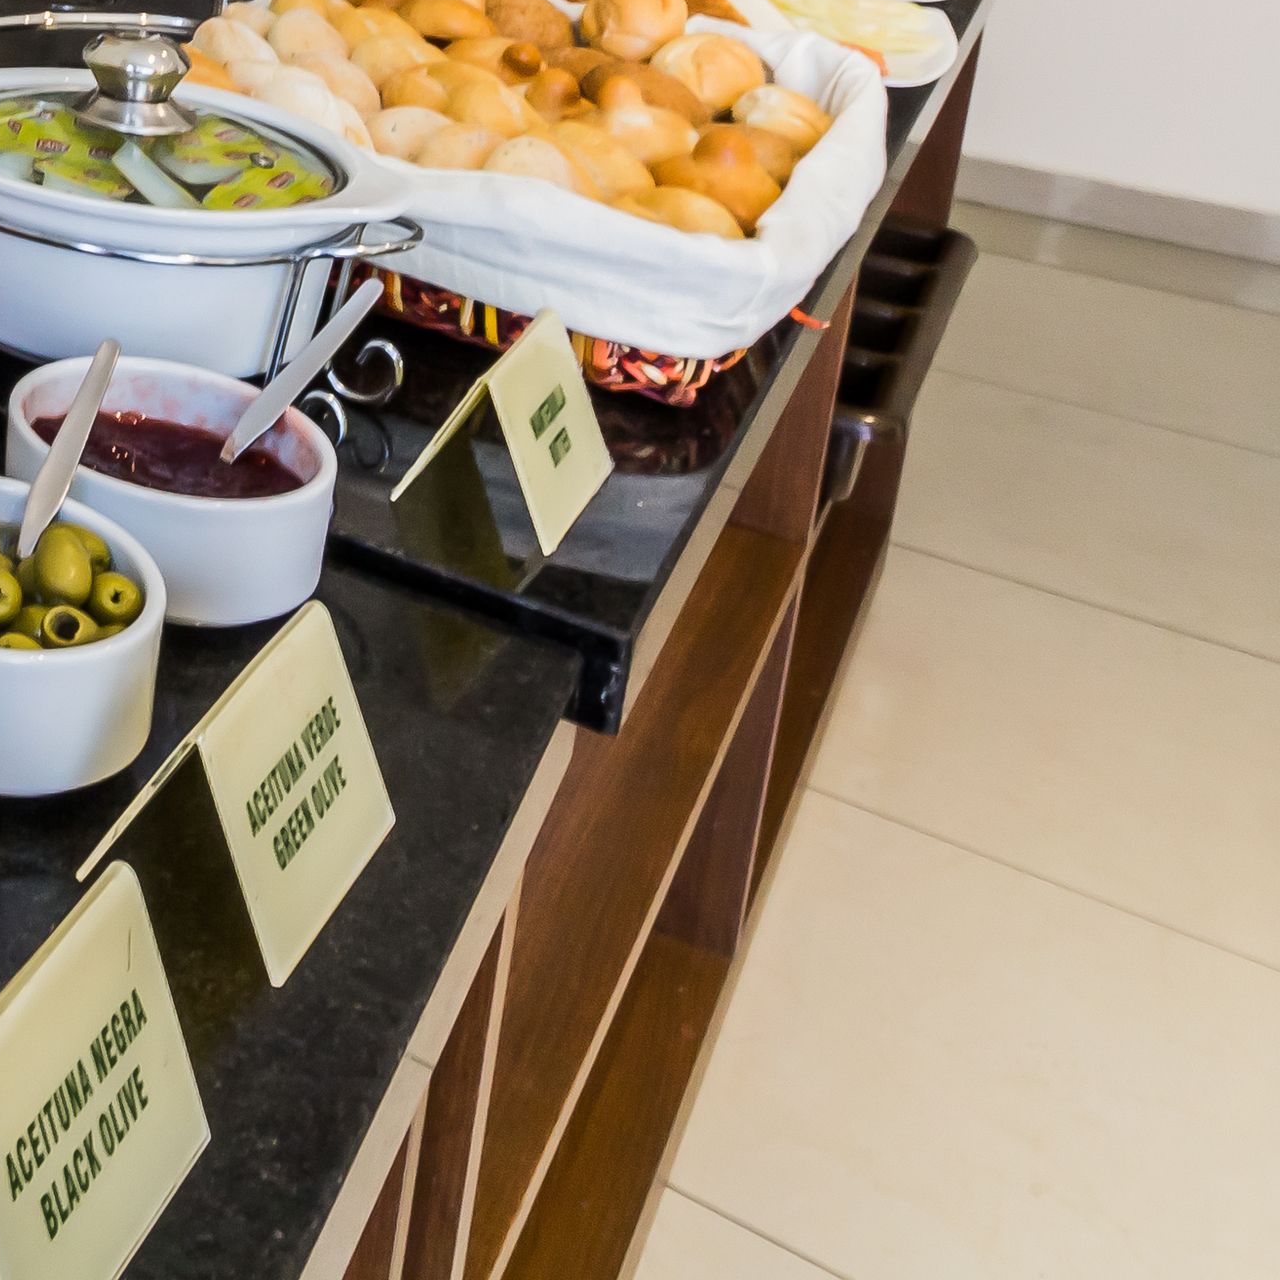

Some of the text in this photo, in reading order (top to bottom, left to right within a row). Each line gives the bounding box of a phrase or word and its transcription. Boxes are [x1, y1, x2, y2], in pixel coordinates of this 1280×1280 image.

[245, 695, 342, 838] ACEITUNA VERDE
[272, 754, 348, 871] GREEN OLIVE
[4, 988, 149, 1202] ACEITUNA NEGRA
[39, 1064, 151, 1242] BLACK OLIVE
